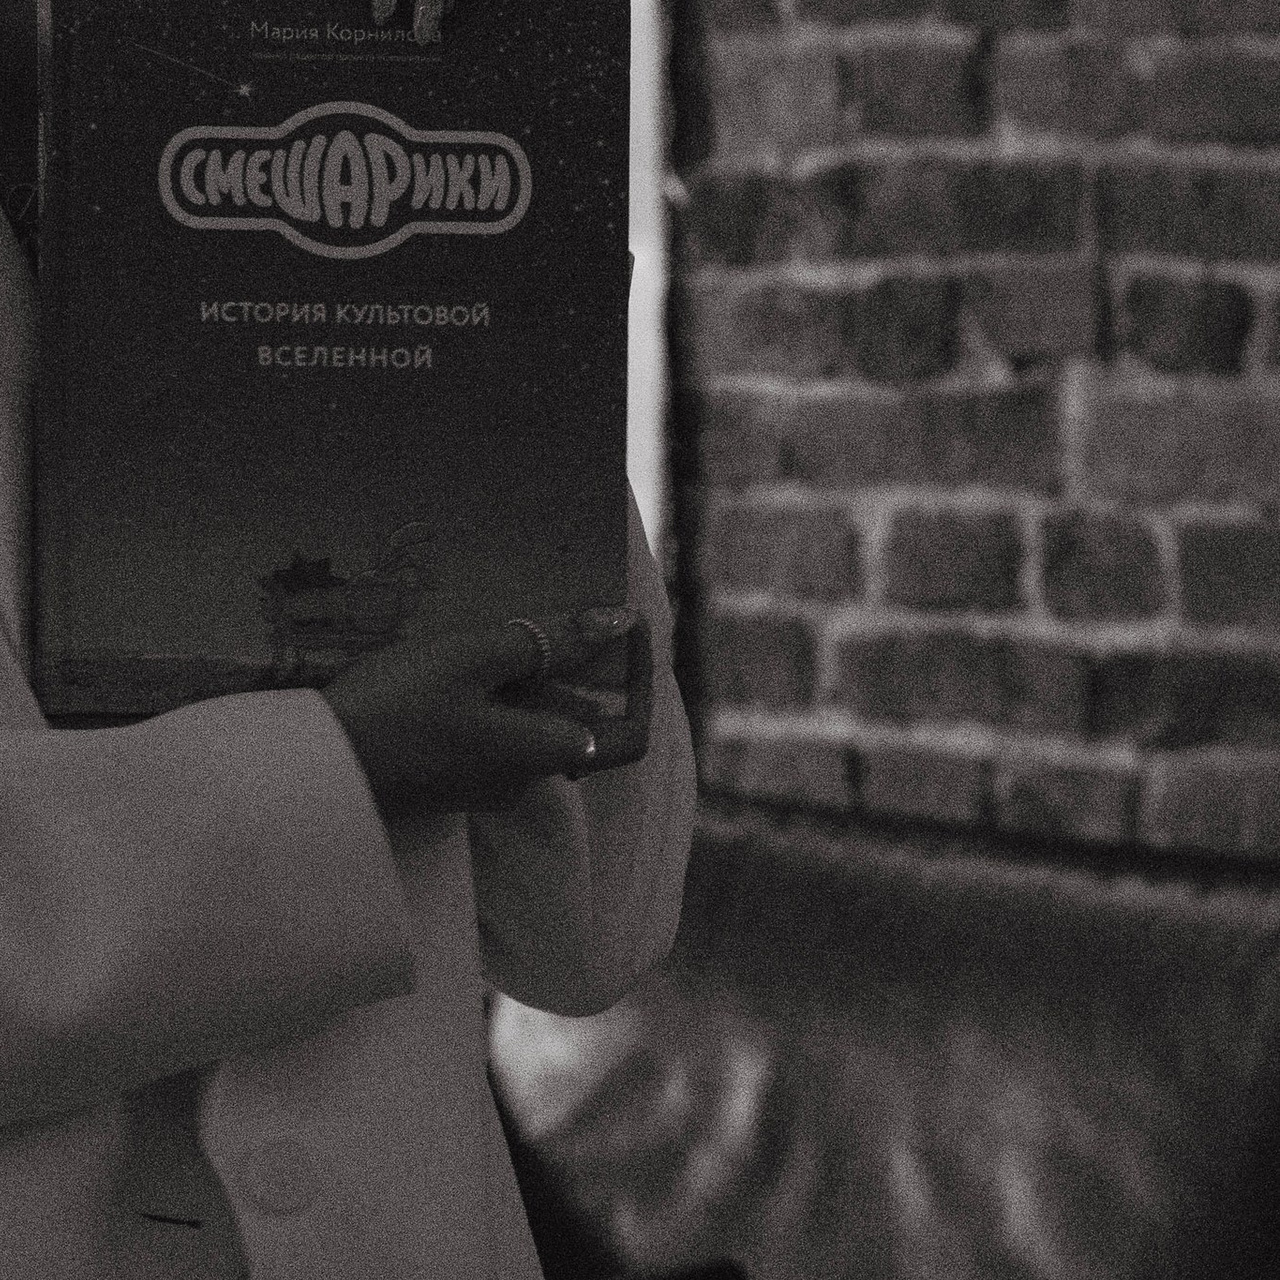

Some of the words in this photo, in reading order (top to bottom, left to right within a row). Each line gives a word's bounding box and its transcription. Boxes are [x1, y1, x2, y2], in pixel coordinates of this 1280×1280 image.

[249, 20, 319, 43] Мария
[326, 21, 442, 45] Корнилоа
[180, 130, 511, 228] СМЕШАРИКИ
[200, 301, 327, 324] ИСТОРИЯ
[336, 301, 490, 327] КУЛЬТОВОЙ
[257, 344, 432, 369] ВСЕЛЕННОЙ
